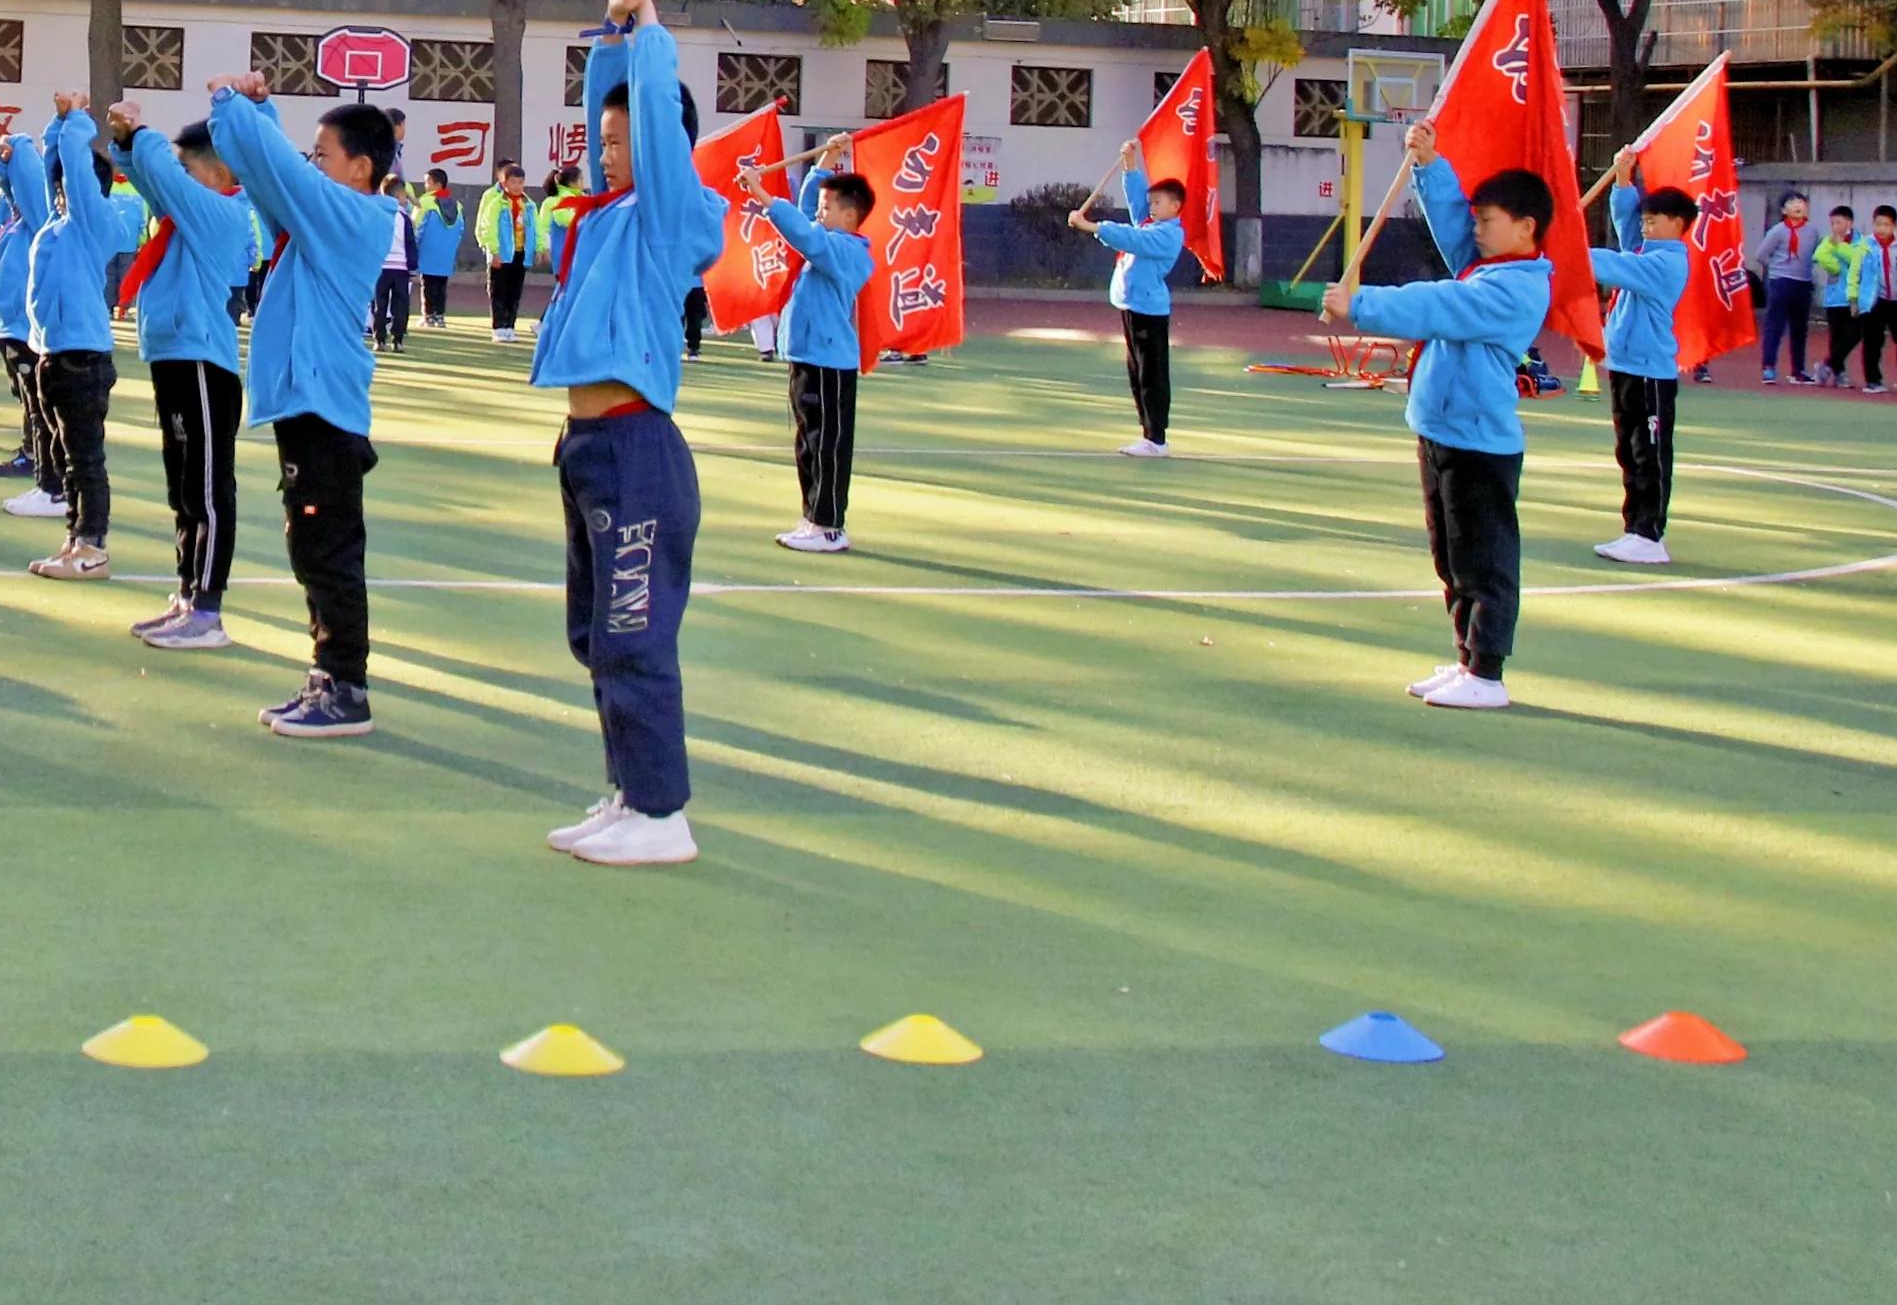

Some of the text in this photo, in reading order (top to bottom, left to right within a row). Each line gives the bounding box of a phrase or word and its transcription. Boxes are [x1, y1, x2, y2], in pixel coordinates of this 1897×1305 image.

[430, 121, 491, 167] 习
[985, 170, 1001, 188] 进
[1318, 181, 1334, 198] 进
